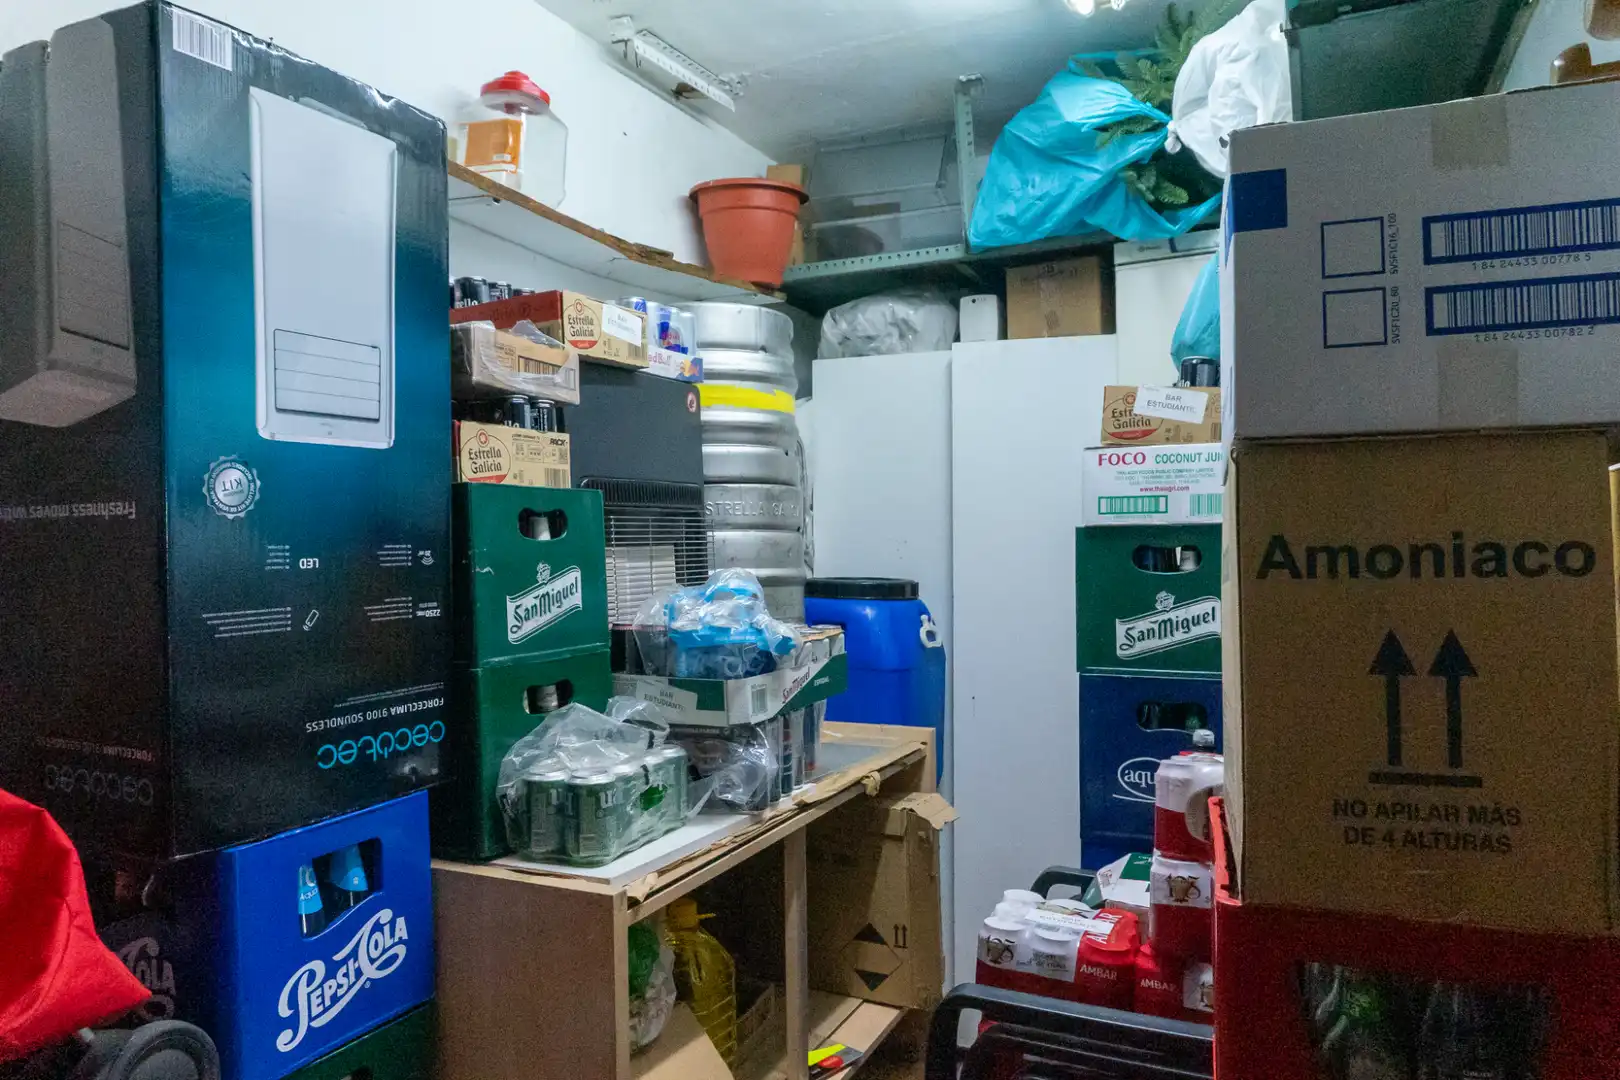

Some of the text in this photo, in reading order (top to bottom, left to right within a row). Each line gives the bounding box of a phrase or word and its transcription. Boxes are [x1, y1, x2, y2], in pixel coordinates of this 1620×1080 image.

[1500, 257, 1537, 268] 24433
[1542, 254, 1580, 265] 00778
[567, 314, 594, 327] Estrella
[569, 325, 595, 337] Galicia
[1503, 329, 1540, 341] 24433
[1545, 326, 1583, 338] 00782
[1165, 393, 1182, 402] BAR
[1113, 417, 1151, 429] Galicia
[468, 447, 502, 461] Estrella
[1098, 451, 1147, 467] FOCO
[1154, 452, 1203, 464] COCONUT
[470, 460, 503, 475] Galicia
[221, 477, 243, 492] KIT
[30, 505, 69, 518] moves
[72, 501, 136, 519] Freshness
[299, 557, 319, 569] LED
[1255, 531, 1598, 580] Amoniaco
[305, 697, 444, 732] FORCECLIMA 9100 SOUNDLESS
[316, 720, 446, 769] cecotec
[1124, 768, 1156, 792] aqu
[1332, 798, 1370, 819] NO
[1375, 798, 1461, 824] APILAR
[1343, 827, 1513, 853] DE 4 ALTURAS
[1079, 963, 1118, 981] AMBAR
[1140, 976, 1178, 992] AMBAR
